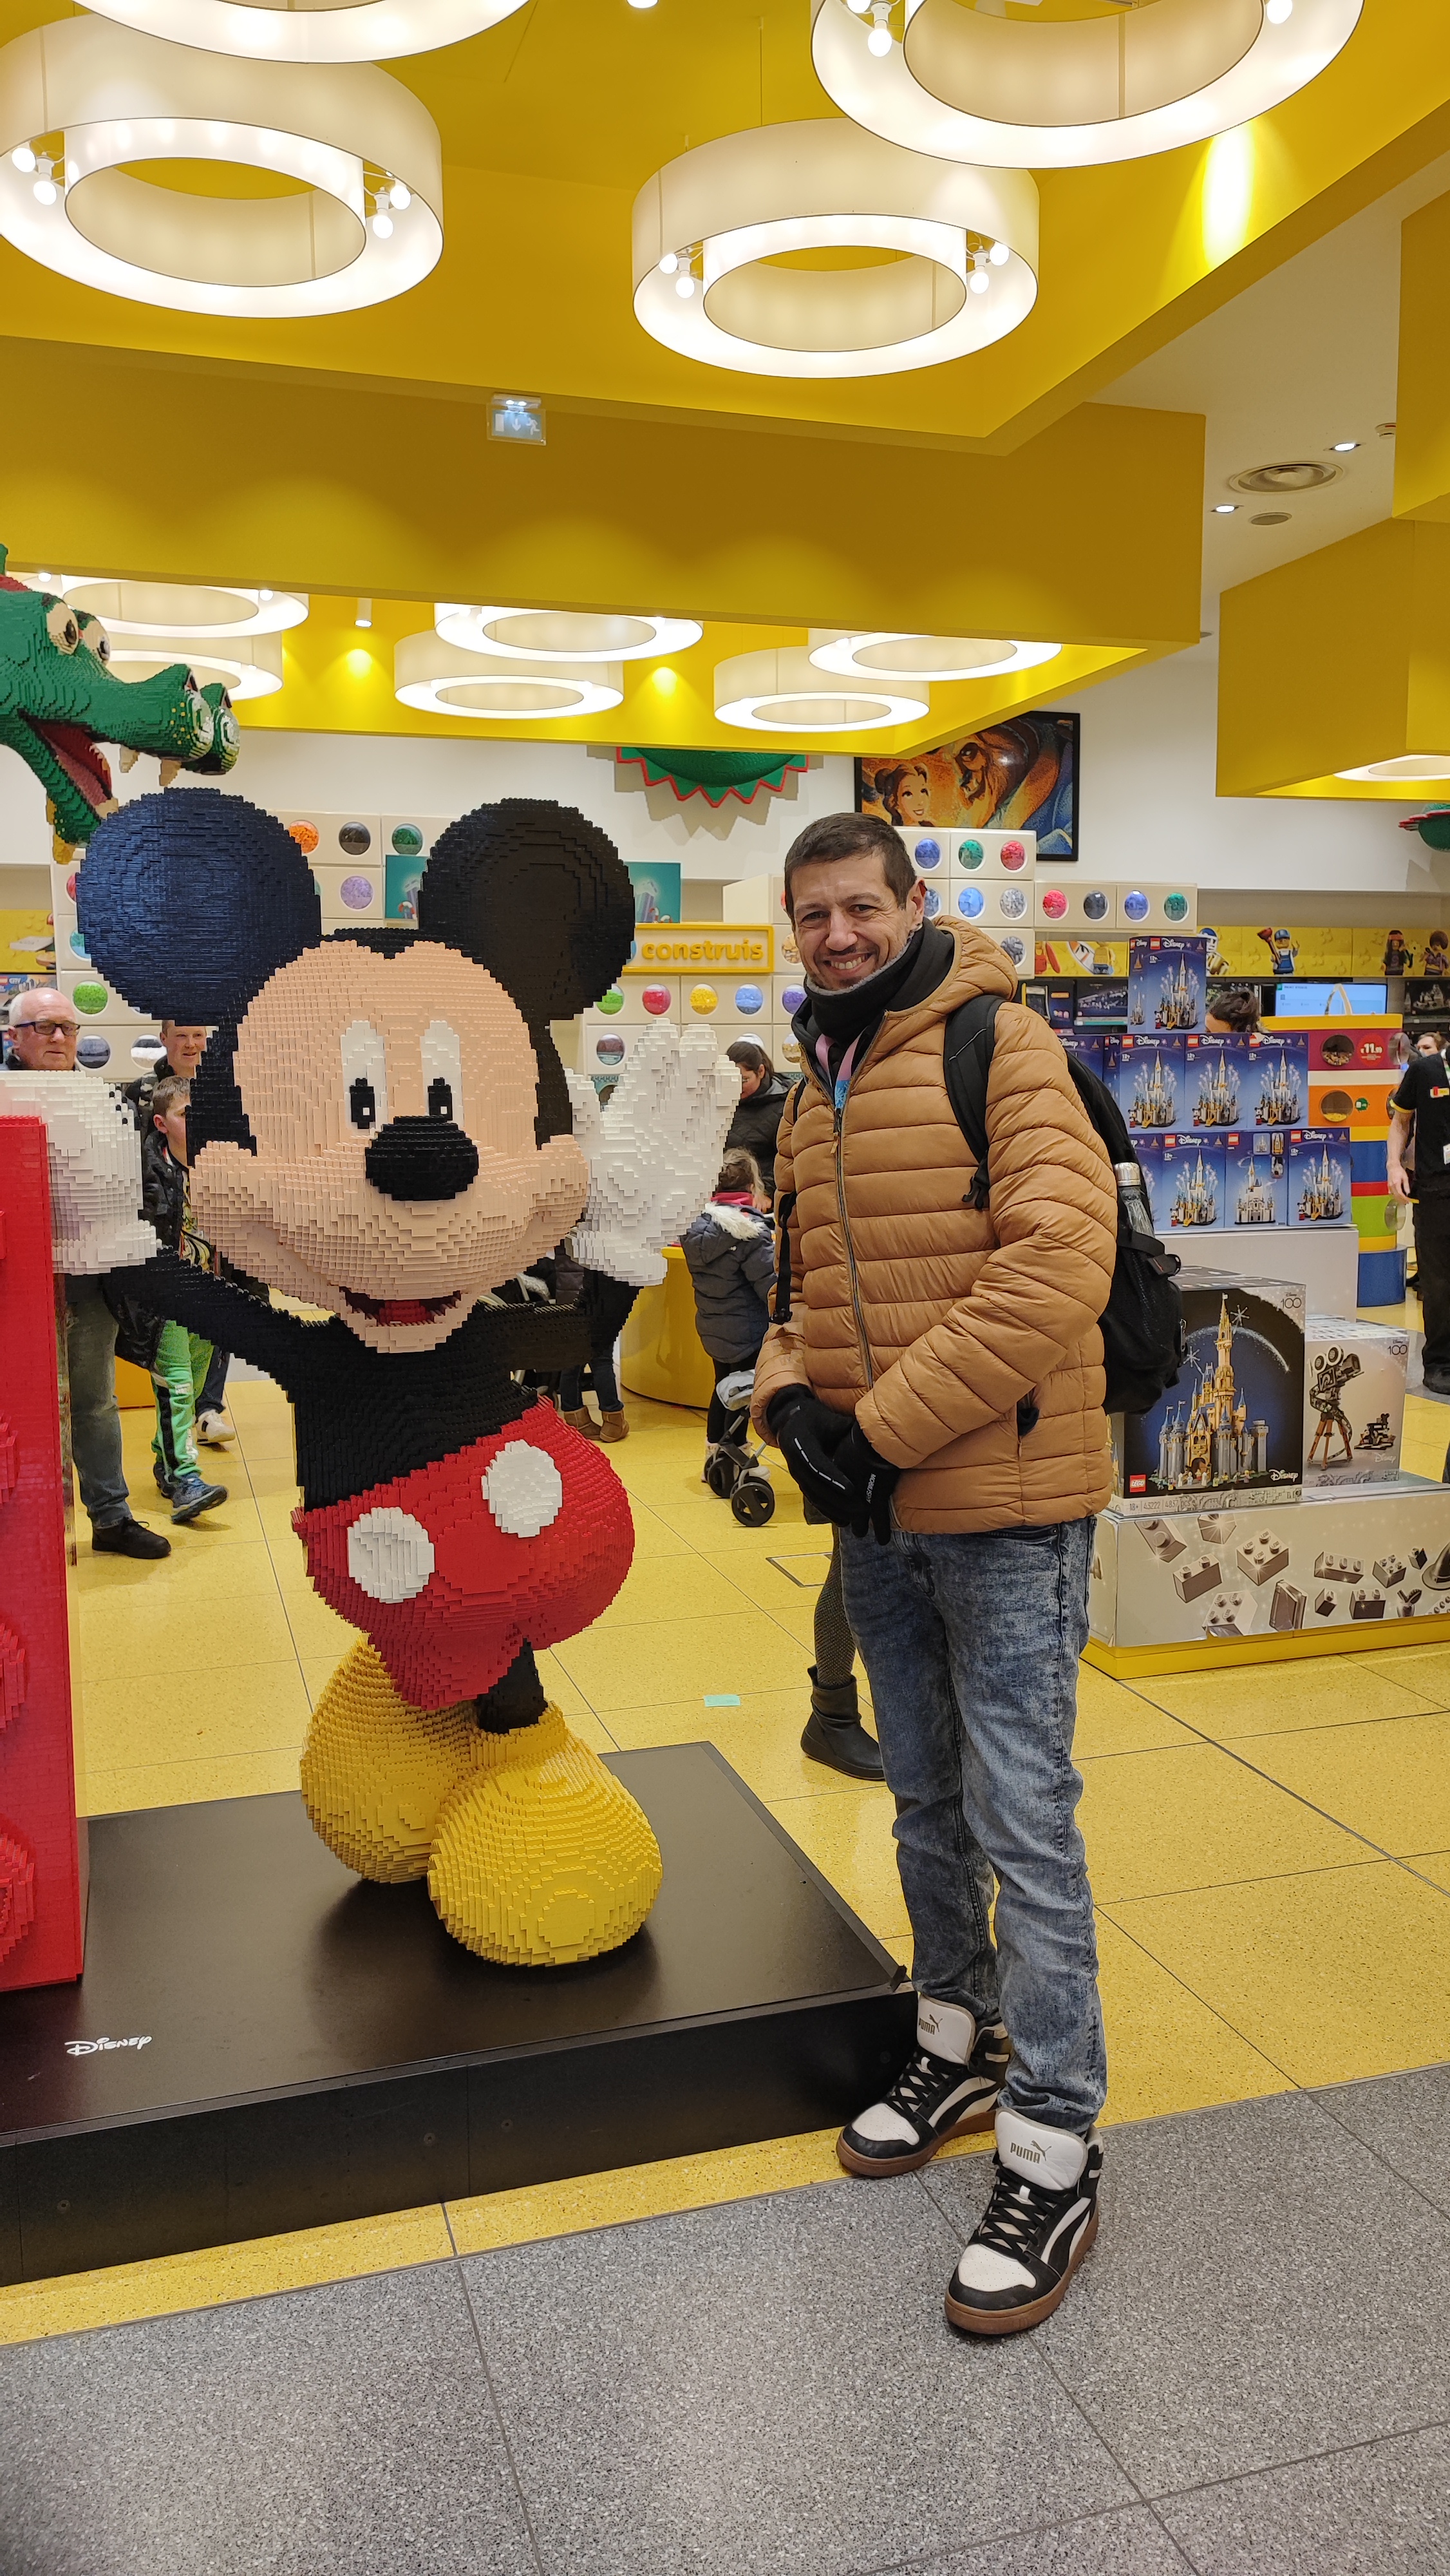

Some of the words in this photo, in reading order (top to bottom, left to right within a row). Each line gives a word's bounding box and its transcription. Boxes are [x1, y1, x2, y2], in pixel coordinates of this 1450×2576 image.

[641, 938, 764, 960] construis
[1161, 937, 1185, 951] Disney
[1135, 1035, 1160, 1047] Disney
[1200, 1034, 1225, 1047] Disney
[1176, 1134, 1202, 1146] Disney
[1302, 1130, 1328, 1142] Disney
[1281, 1298, 1302, 1309] 100
[1388, 1345, 1408, 1356] 100
[1373, 1451, 1397, 1464] Disney
[1268, 1469, 1299, 1482] Disney
[1131, 1479, 1145, 1488] LEGO
[1143, 1501, 1161, 1510] 43222
[64, 2036, 153, 2056] Disney
[1010, 2141, 1041, 2164] PUMA
